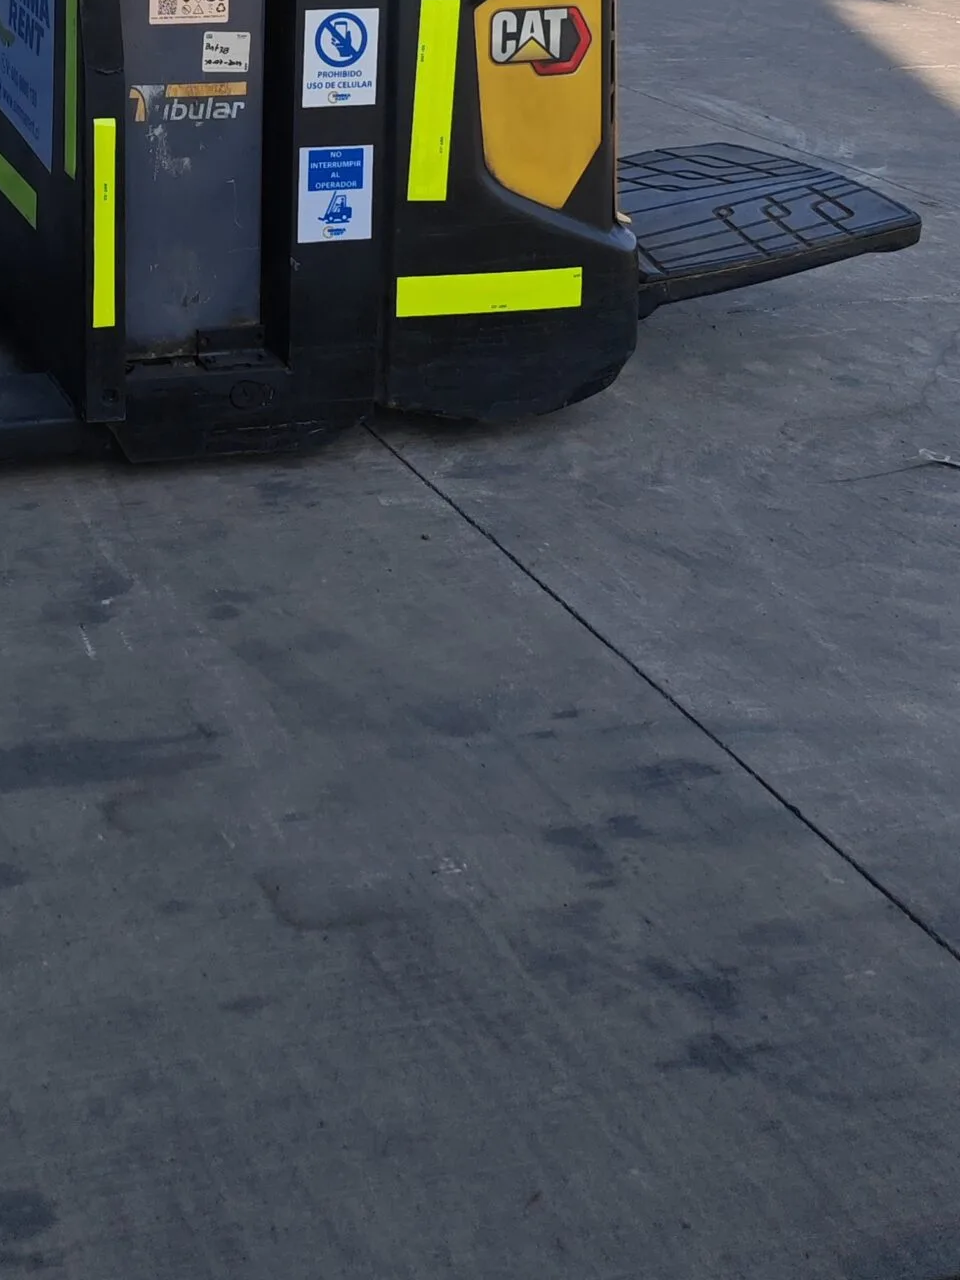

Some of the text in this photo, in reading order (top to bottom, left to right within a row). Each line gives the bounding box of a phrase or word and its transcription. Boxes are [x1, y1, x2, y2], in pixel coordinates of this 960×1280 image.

[492, 8, 568, 63] CAT
[317, 70, 362, 78] PROHIBIDO
[306, 81, 372, 90] USO DE CELULAR
[310, 160, 361, 169] INTERRUMPIR
[315, 180, 357, 189] OPERADOR
